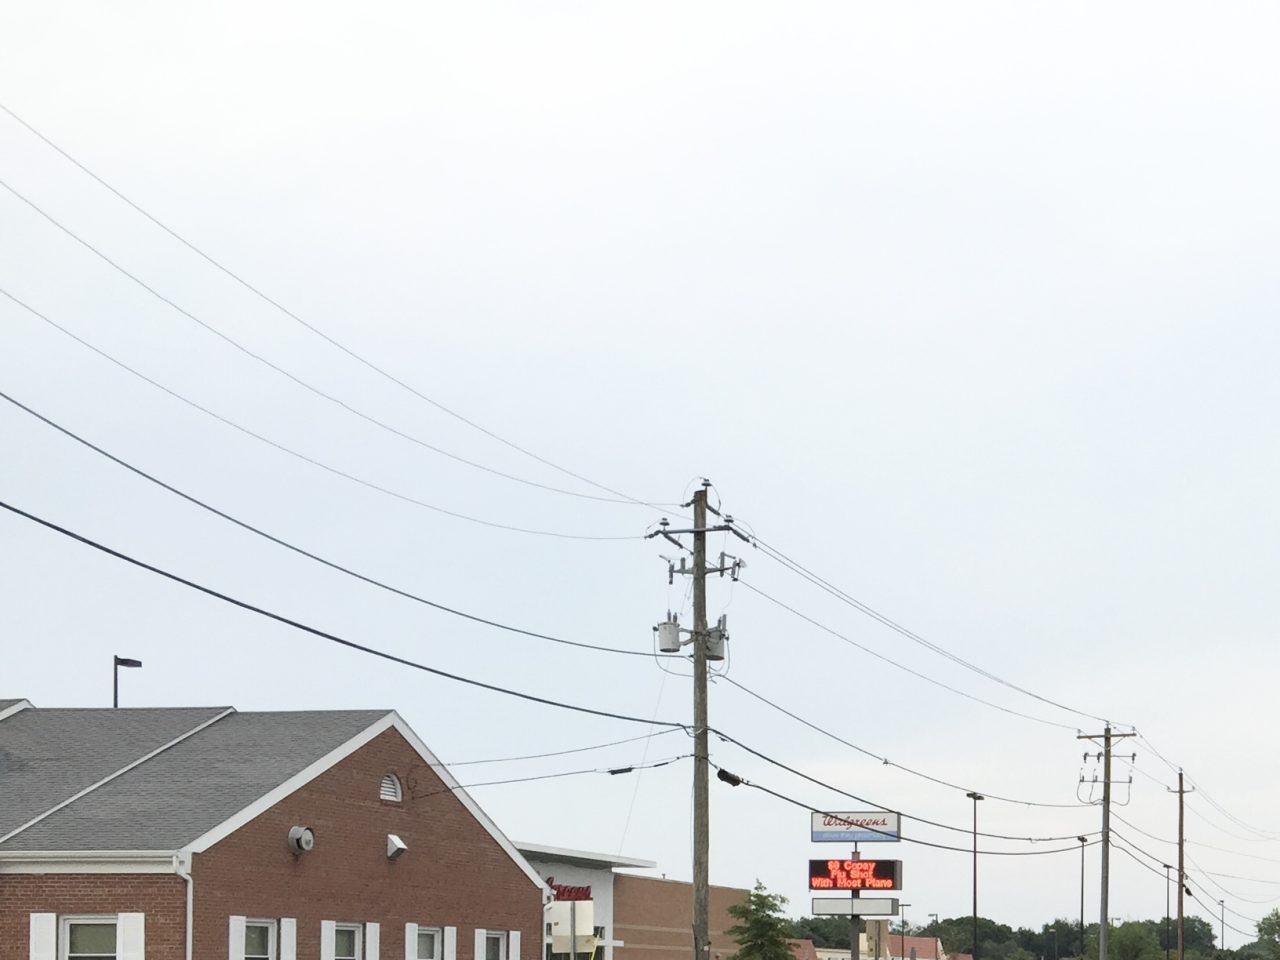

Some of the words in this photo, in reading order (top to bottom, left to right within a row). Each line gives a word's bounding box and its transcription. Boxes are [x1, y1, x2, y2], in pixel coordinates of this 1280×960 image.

[822, 815, 888, 830] Walgreens
[843, 861, 876, 871] Copay
[830, 870, 847, 879] Flu
[849, 870, 873, 879] Shot
[811, 877, 834, 888] With
[836, 878, 862, 888] Most
